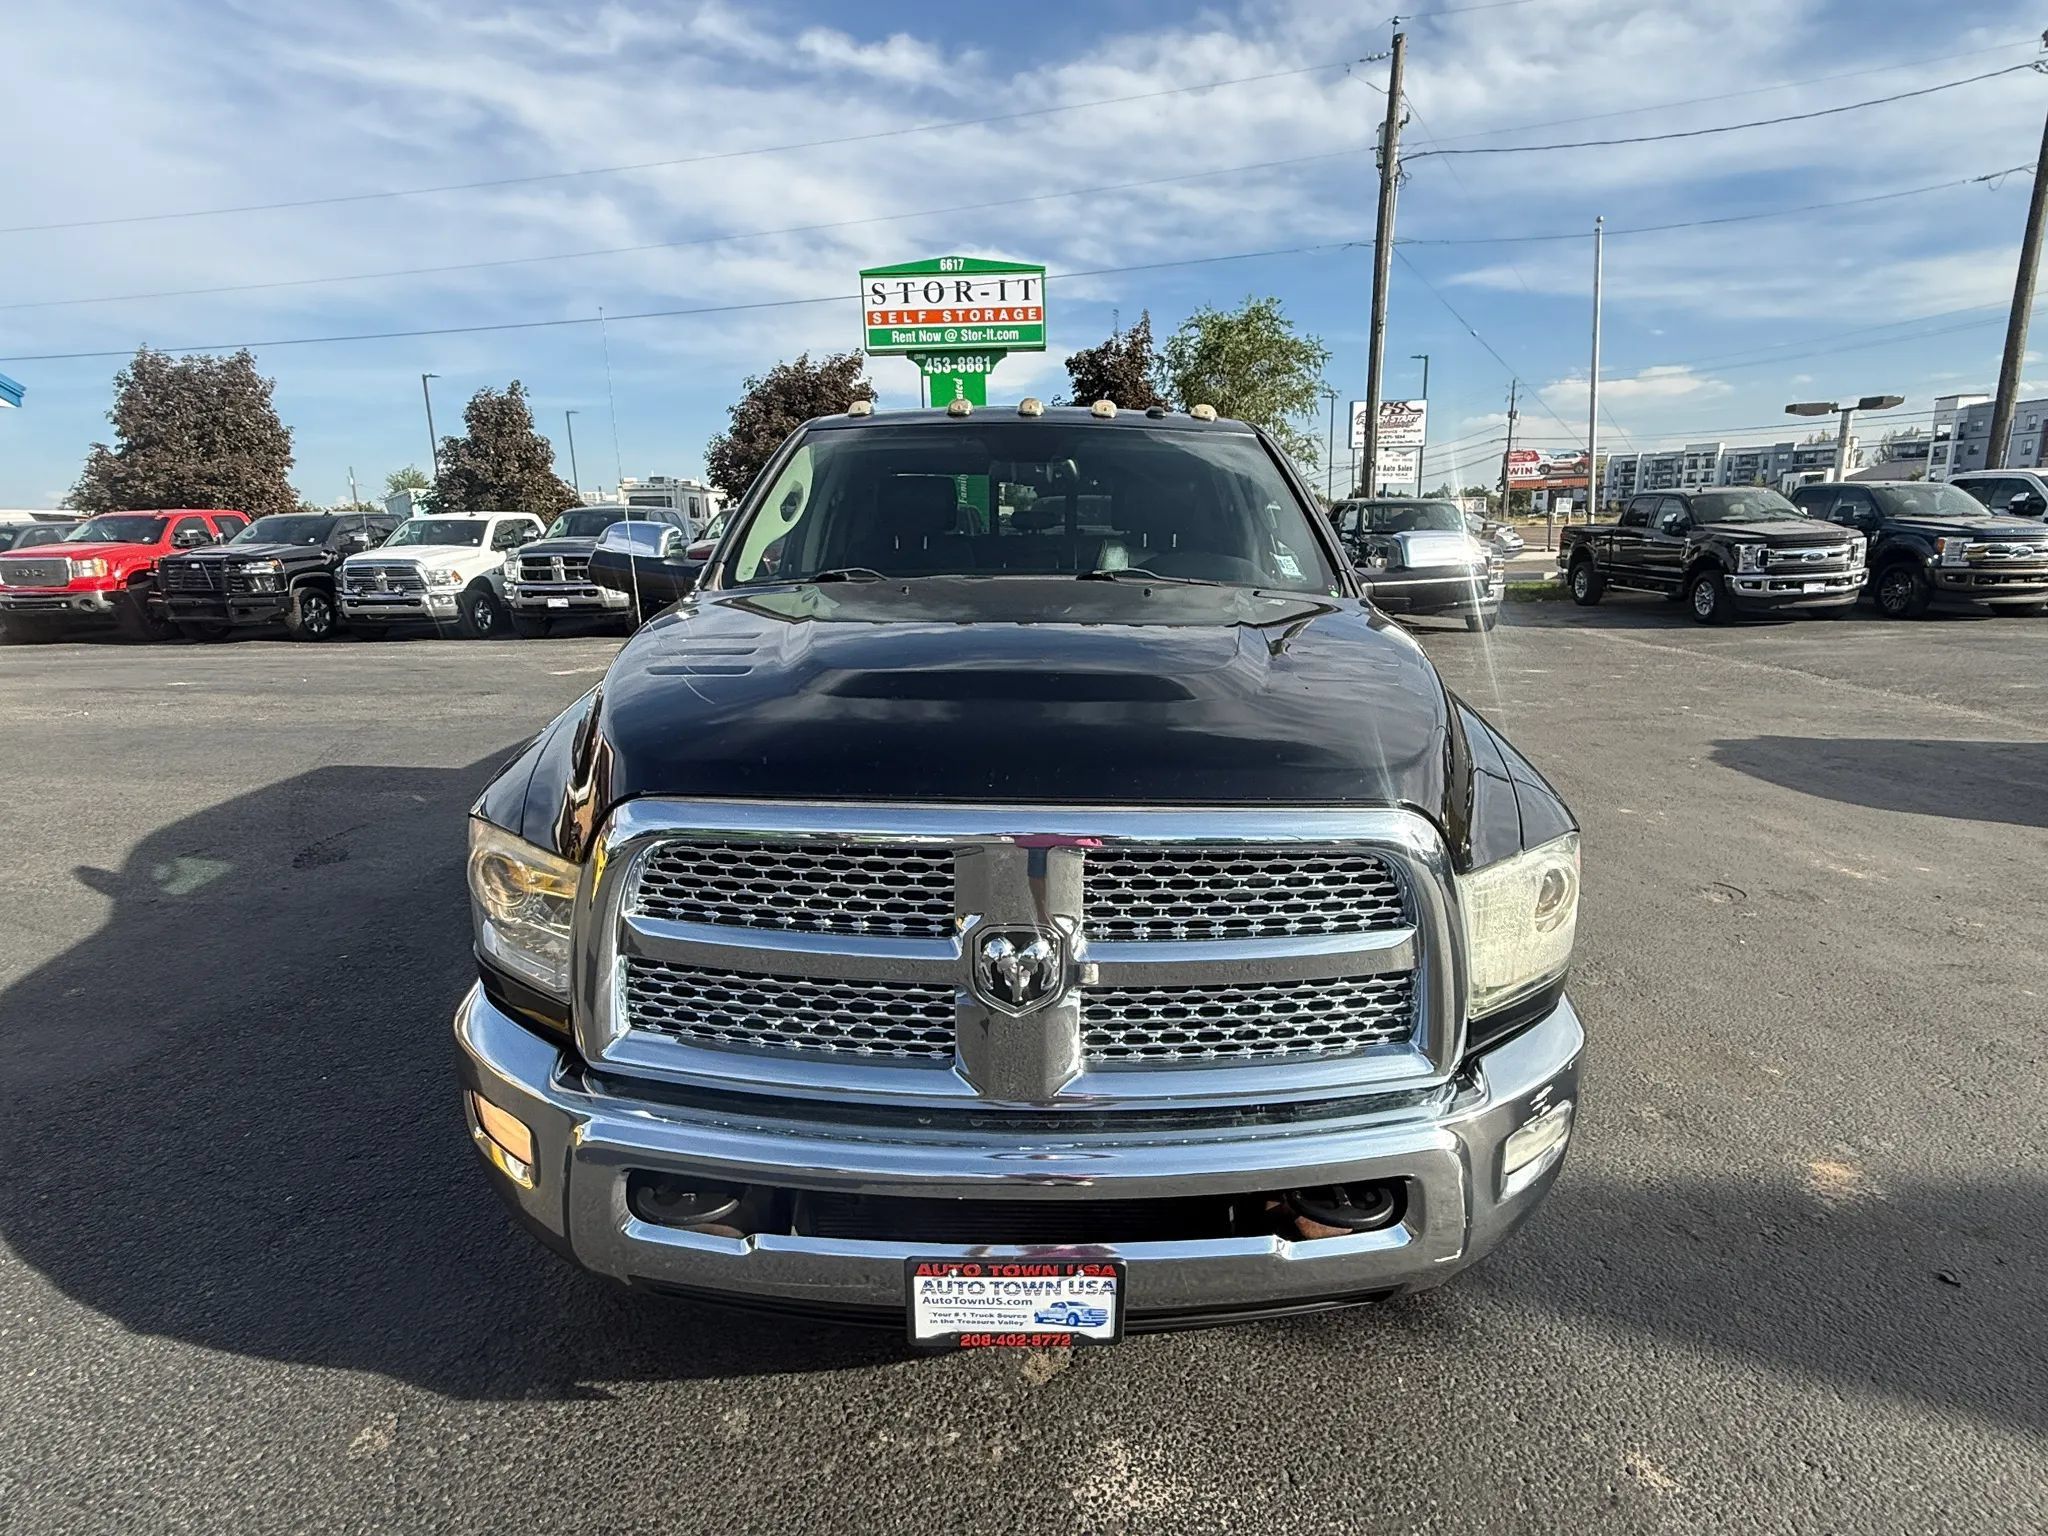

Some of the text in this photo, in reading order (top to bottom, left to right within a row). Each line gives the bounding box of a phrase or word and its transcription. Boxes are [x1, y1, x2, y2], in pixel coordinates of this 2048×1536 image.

[940, 258, 965, 271] 6617
[871, 278, 1037, 305] STOR-IT
[872, 308, 1037, 325] SELF STORAGE
[892, 329, 1019, 343] Rent Now @ Stor-It.com
[924, 355, 991, 374] 453-8881
[1508, 466, 1533, 475] WIN
[916, 1263, 1117, 1277] AUTO TOWN USA
[920, 1280, 1117, 1296] AUTO TOWN USA
[922, 1296, 1033, 1306] AutoTownUS.com
